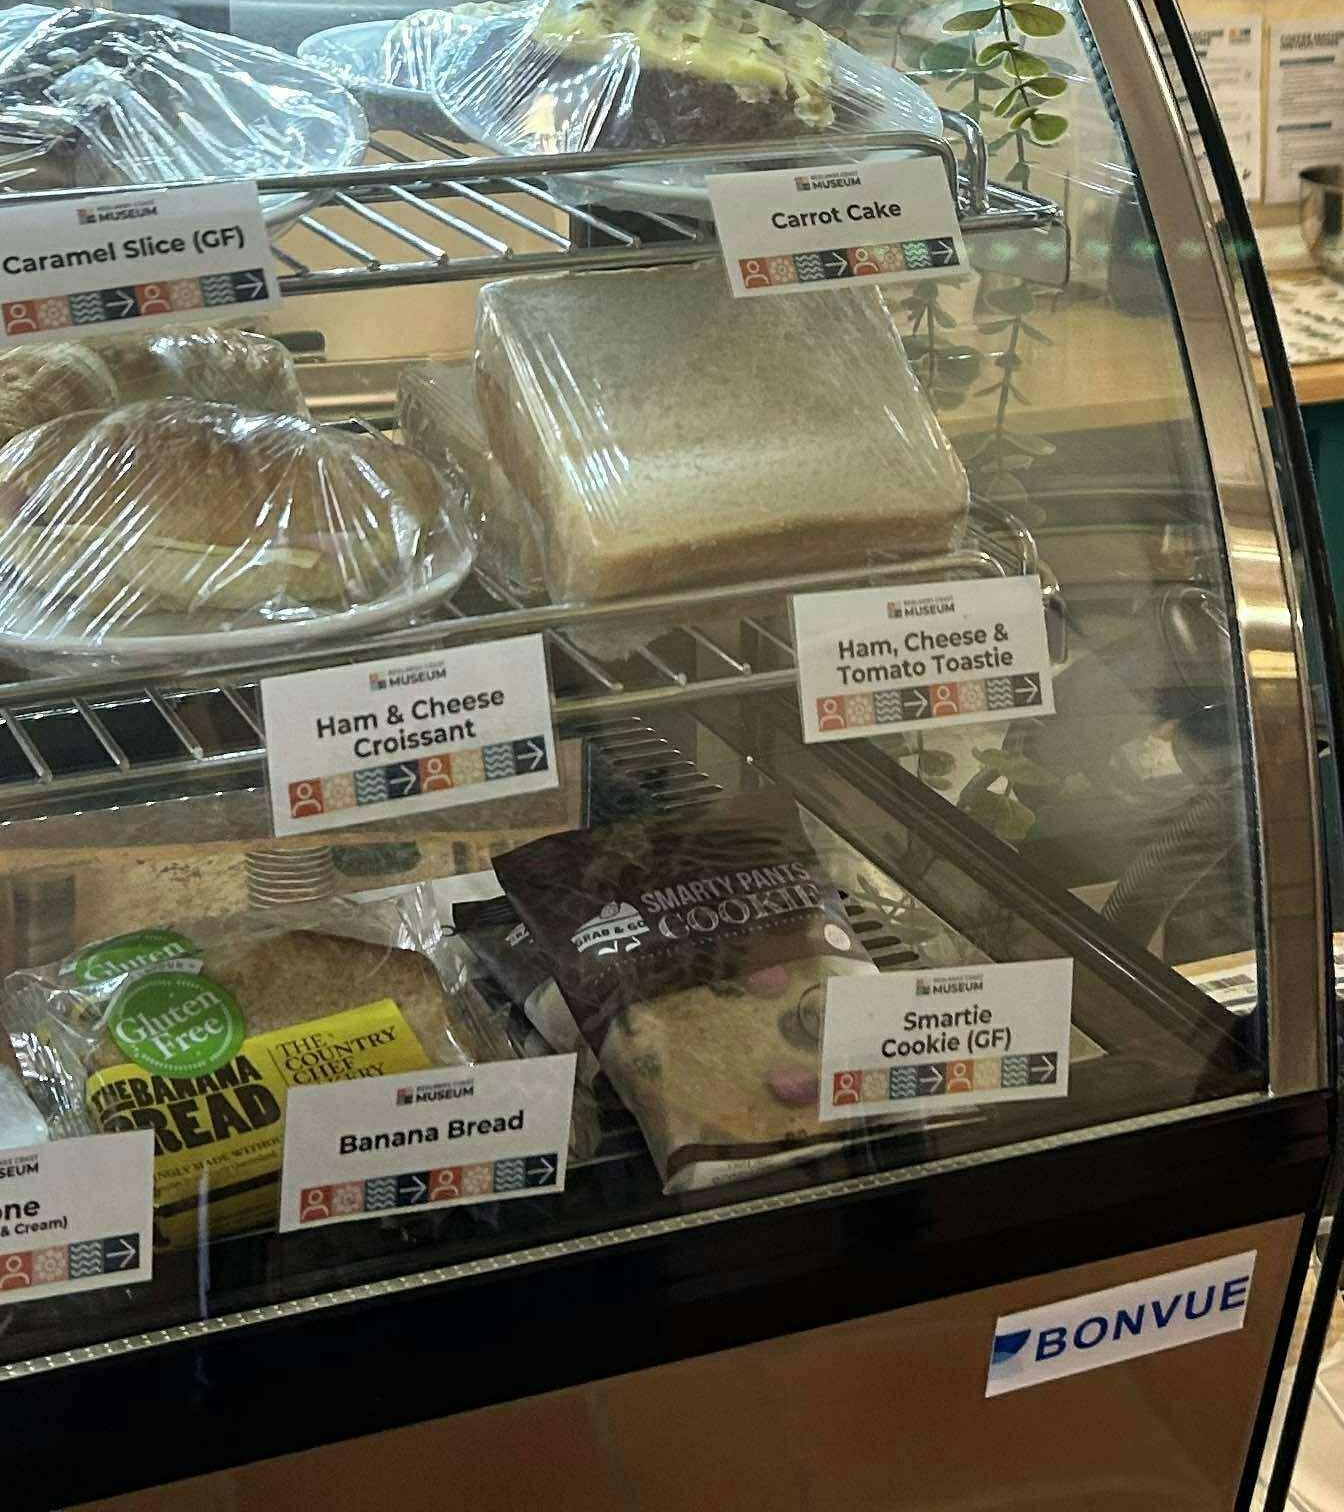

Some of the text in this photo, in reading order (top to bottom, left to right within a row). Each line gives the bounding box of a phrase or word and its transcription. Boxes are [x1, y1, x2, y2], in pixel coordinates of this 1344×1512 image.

[812, 176, 862, 191] MUSEUM
[98, 205, 159, 224] MUSEUM
[771, 200, 903, 230] Carrot Cake
[2, 224, 246, 276] Caramel Slice (GF)
[904, 602, 956, 618] MUSEUM
[838, 622, 1009, 660] Ham, Cheese &
[388, 667, 447, 689] MUSEUM
[836, 646, 1014, 685] Tomato Toastie
[316, 688, 505, 738] Ham & Cheese
[353, 718, 477, 759] Croissant
[640, 862, 811, 914] SMARTY PANTS
[658, 882, 826, 940] COOKIE
[83, 937, 188, 987] Gluten
[932, 981, 984, 995] MUSEUM
[114, 989, 222, 1048] Gluten
[903, 1003, 993, 1032] Smartie
[151, 1011, 225, 1064] Free
[275, 1035, 323, 1060] THE
[284, 1026, 398, 1073] COUNTRY
[881, 1026, 1013, 1059] Cookie (GF)
[90, 1054, 263, 1113] THE BANANA
[292, 1058, 359, 1085] CHEF
[415, 1085, 475, 1104] MUSEUM
[339, 1109, 525, 1155] Banana Bread
[0, 1225, 11, 1238] &
[14, 1215, 69, 1235] Cream)
[1035, 1275, 1251, 1363] BONVUE
